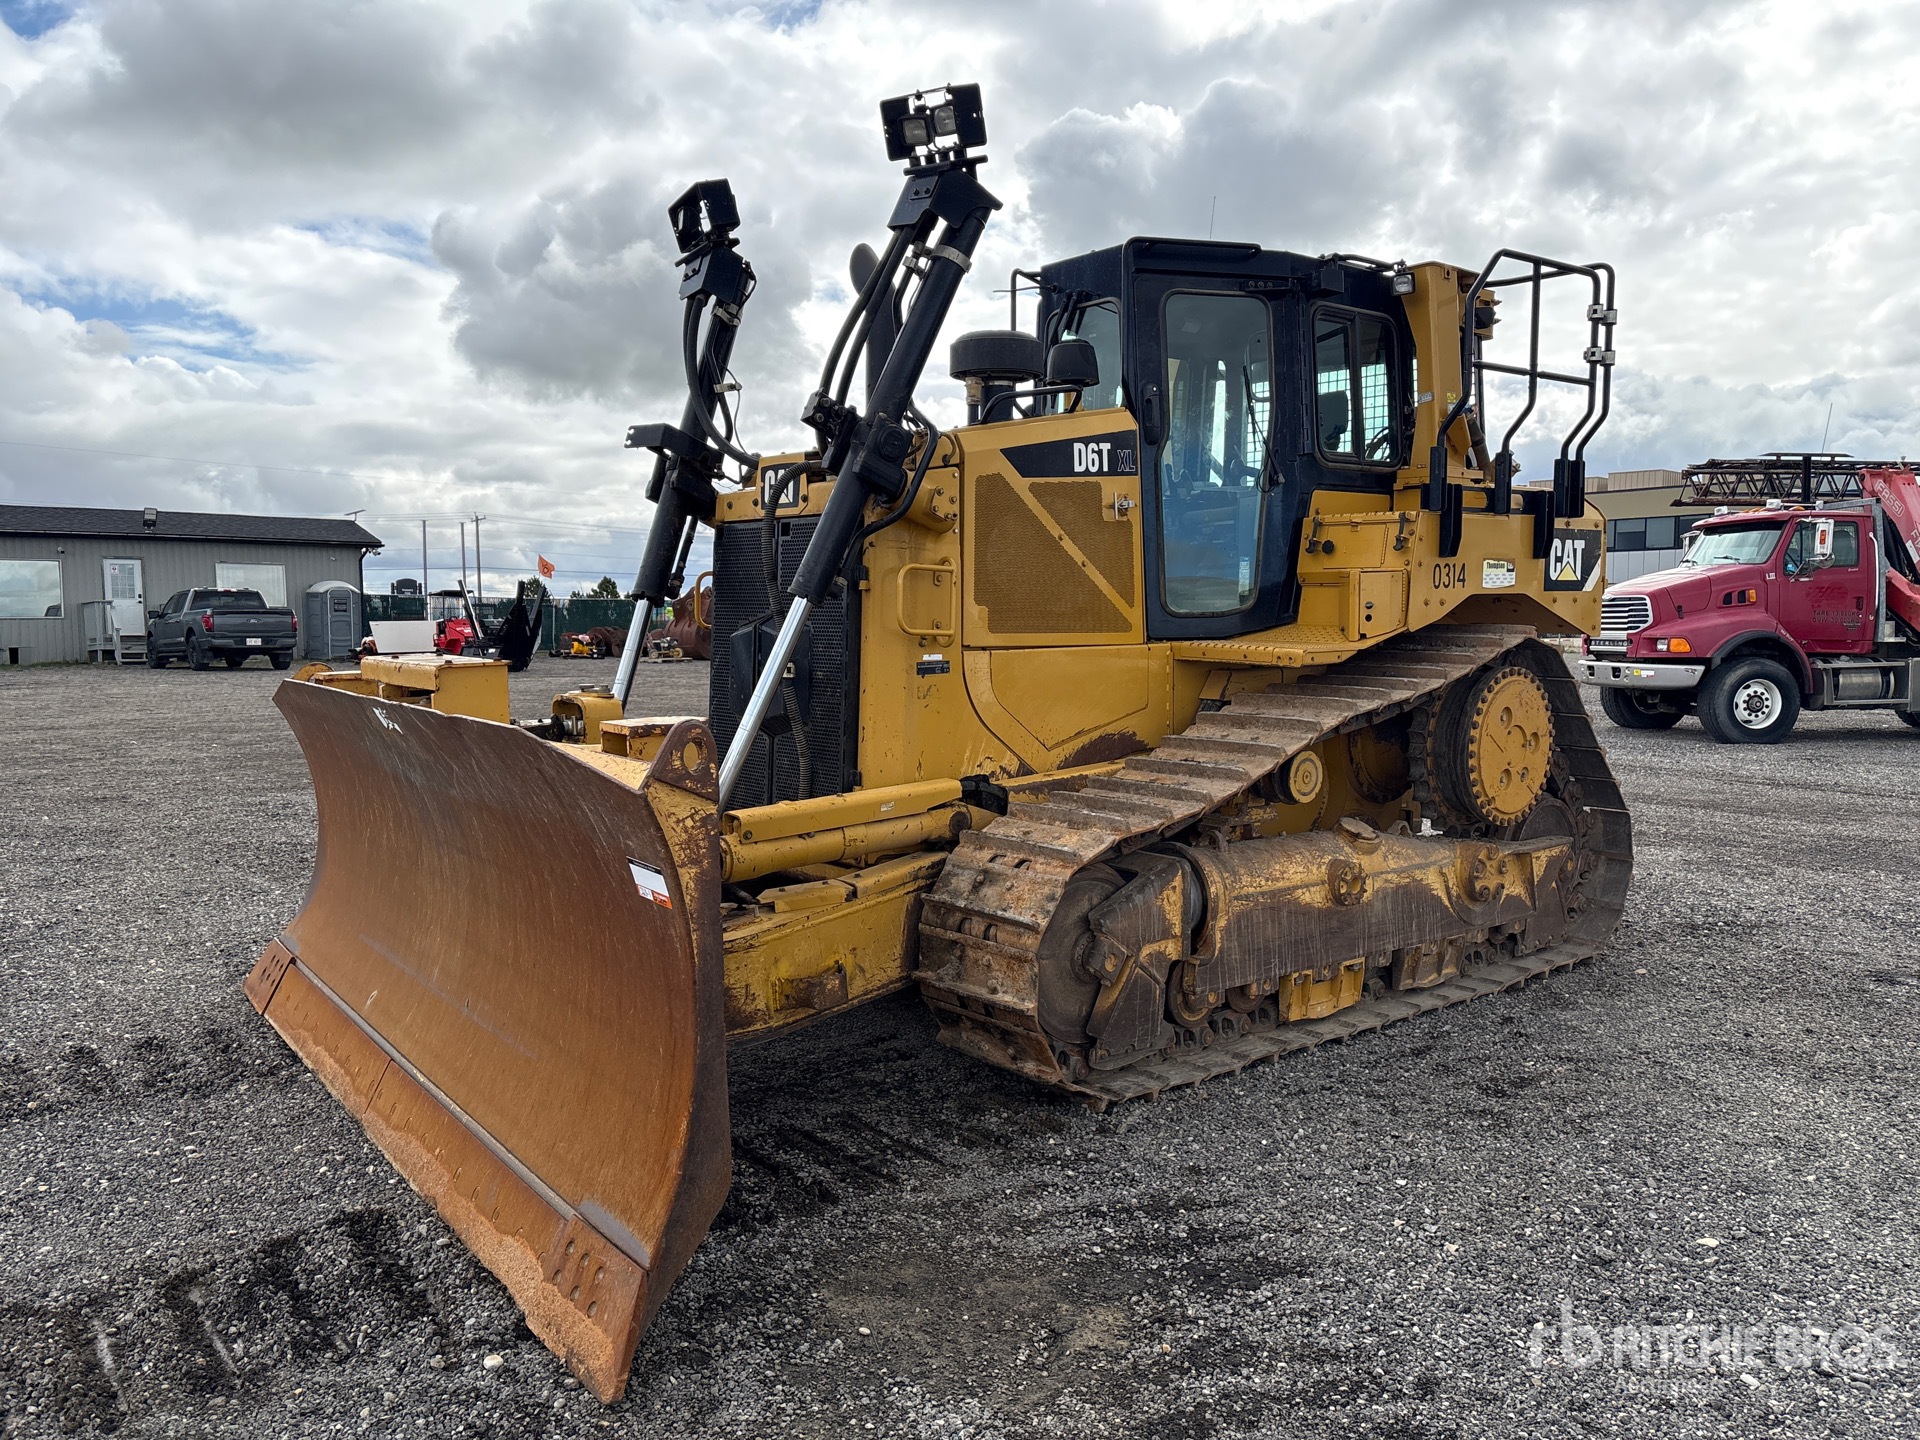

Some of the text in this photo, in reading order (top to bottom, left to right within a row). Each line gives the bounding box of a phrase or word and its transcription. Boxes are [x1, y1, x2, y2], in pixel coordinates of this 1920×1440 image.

[1073, 442, 1136, 473] D6T XL
[1876, 482, 1904, 515] FASSI
[1432, 562, 1466, 589] 0314
[1549, 538, 1586, 581] CAT
